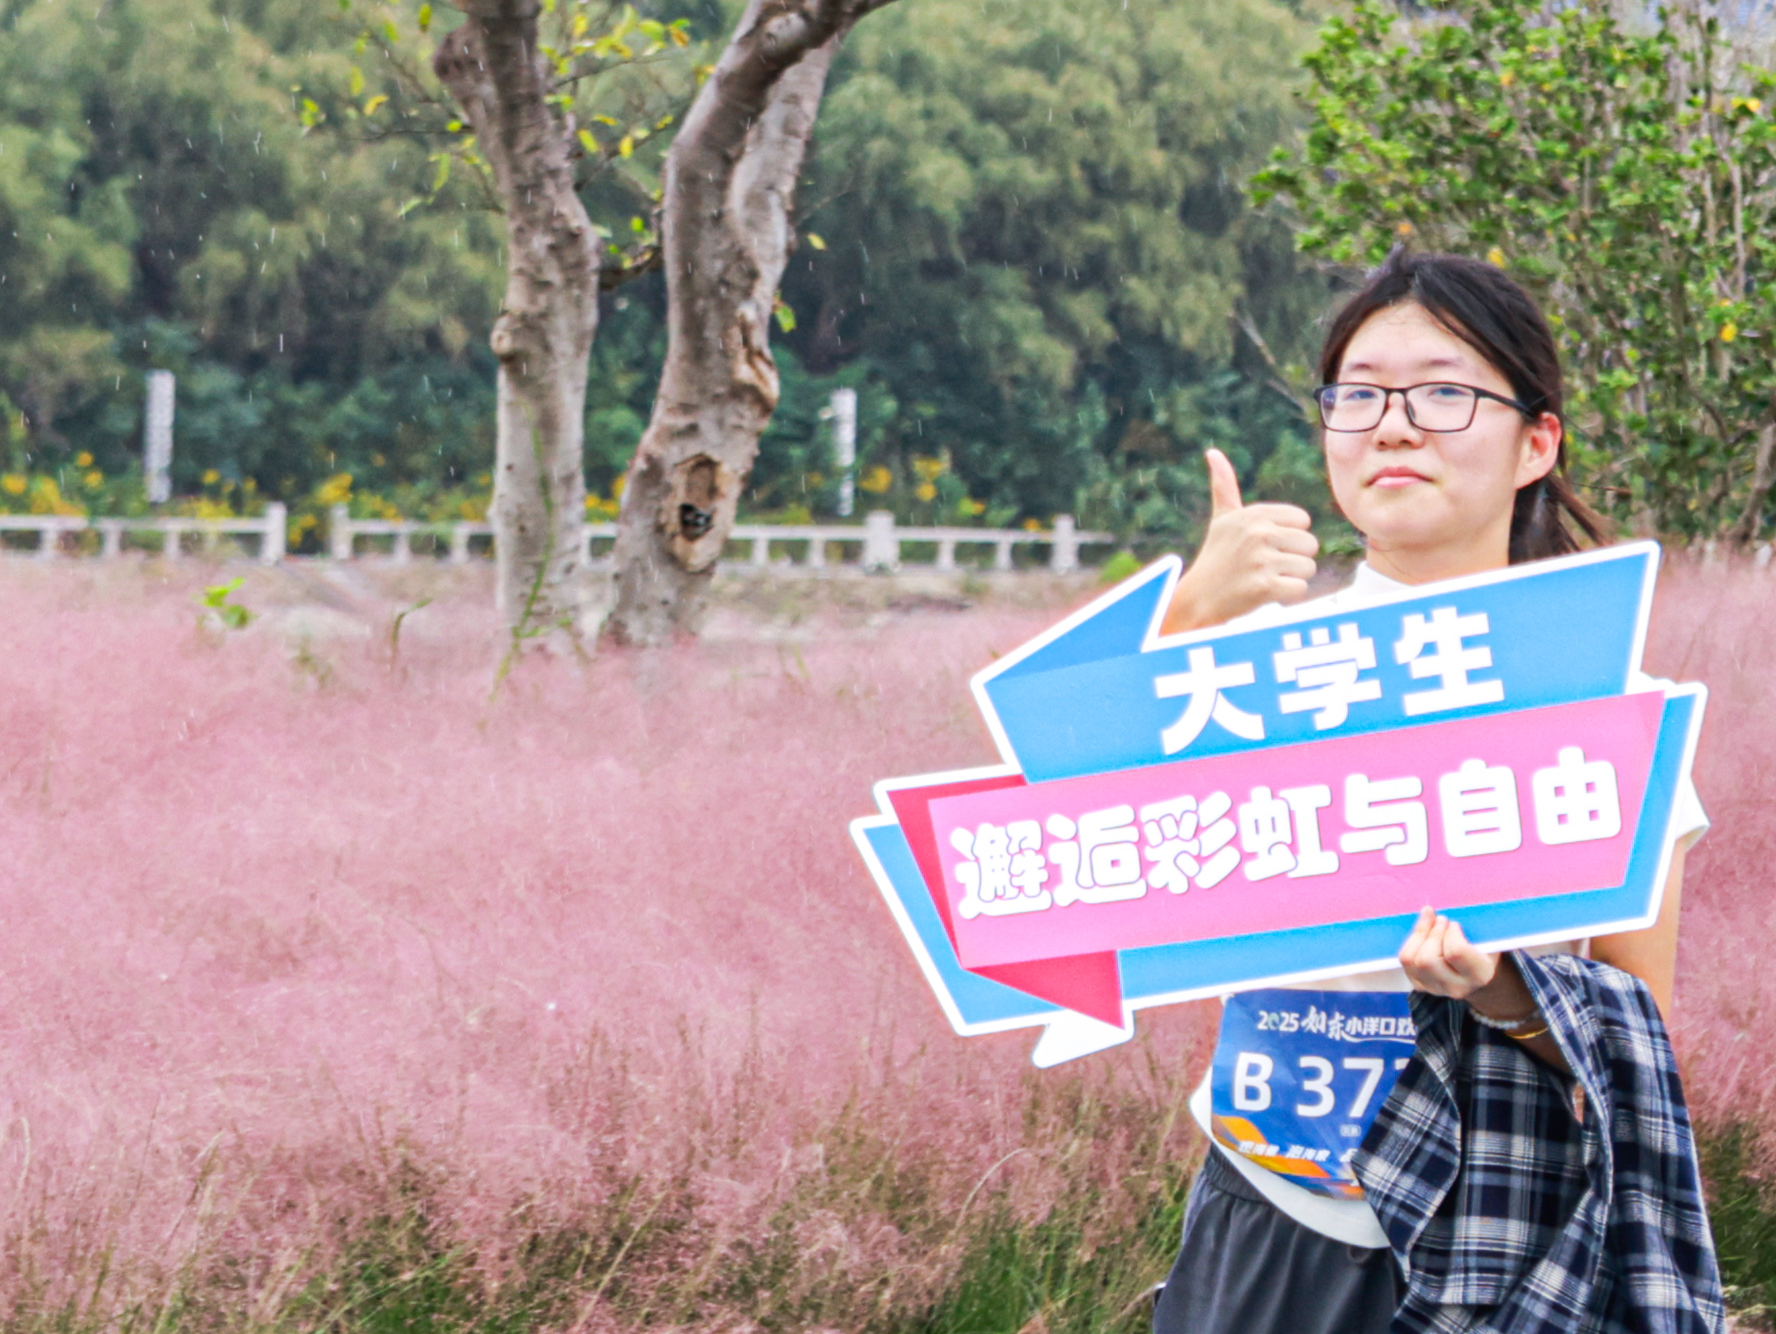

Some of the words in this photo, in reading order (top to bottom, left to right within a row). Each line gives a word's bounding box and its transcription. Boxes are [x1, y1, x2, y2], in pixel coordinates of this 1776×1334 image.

[1155, 606, 1504, 754] 大学生
[949, 747, 1623, 920] 邂逅彩虹与自由
[1234, 1052, 1274, 1112] B
[1296, 1056, 1411, 1117] 37
